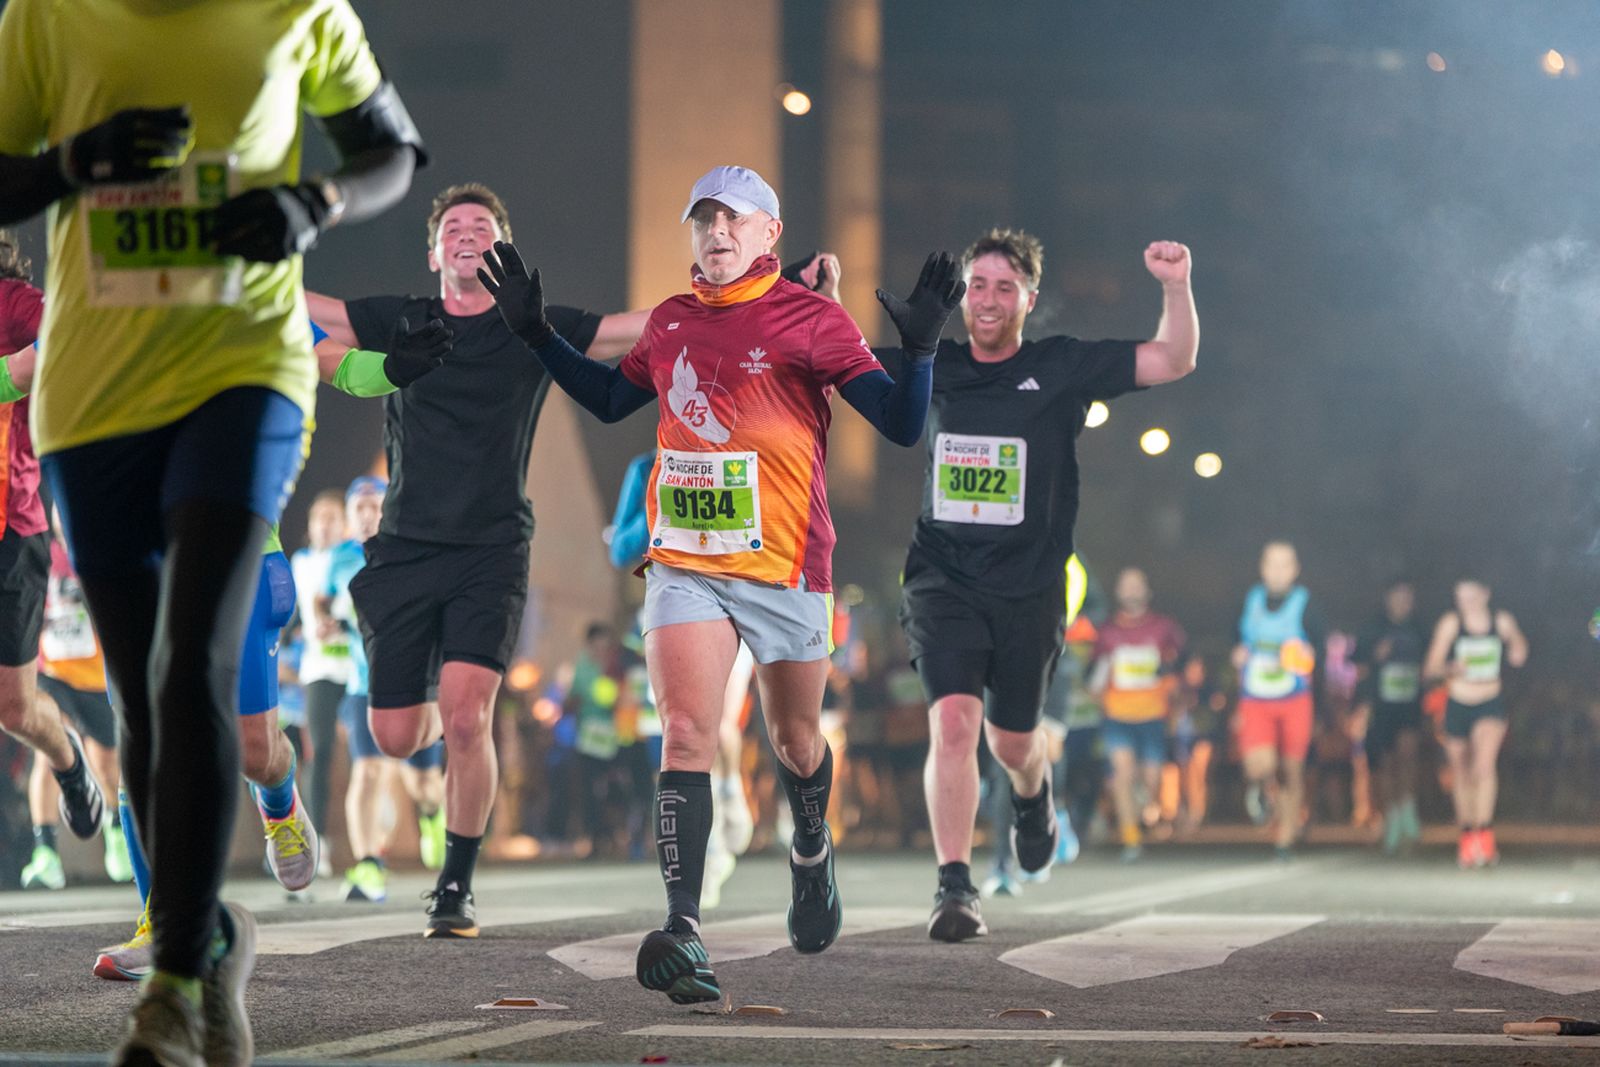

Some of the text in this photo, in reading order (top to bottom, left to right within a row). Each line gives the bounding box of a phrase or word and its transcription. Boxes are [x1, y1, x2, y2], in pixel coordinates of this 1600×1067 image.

[115, 210, 209, 254] 3161
[681, 399, 708, 428] 43
[666, 475, 681, 485] SAN
[681, 475, 714, 488] ANTÓN
[676, 464, 713, 475] NOCHE DE
[950, 467, 1006, 494] 3022
[673, 488, 736, 520] 9134
[657, 789, 688, 883] kalenji
